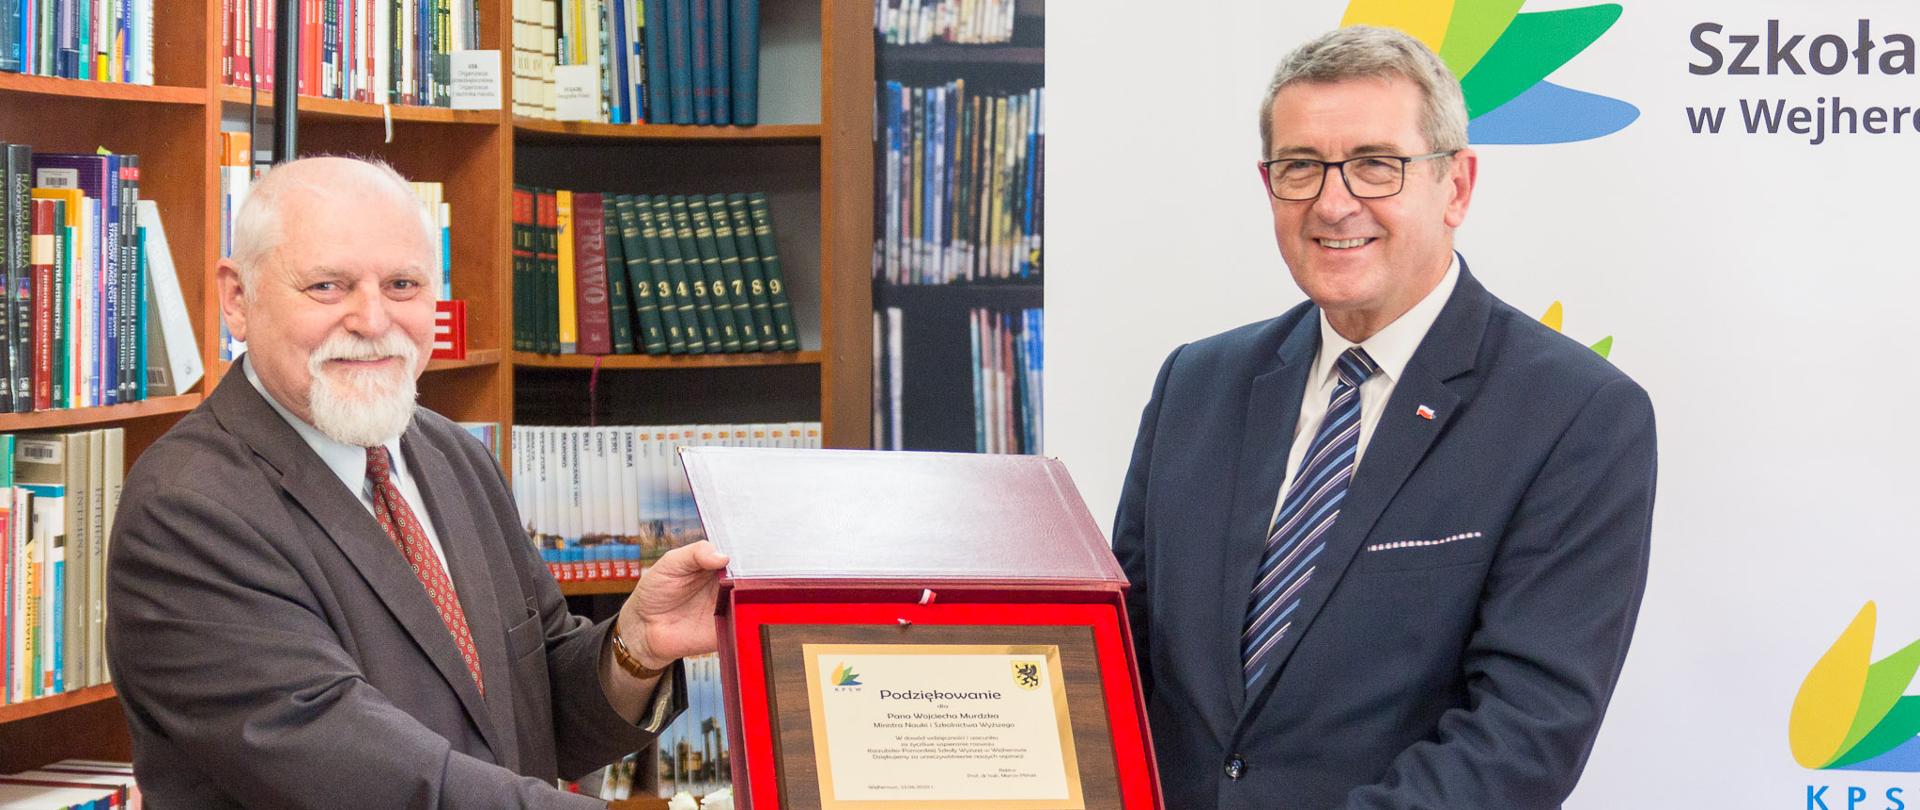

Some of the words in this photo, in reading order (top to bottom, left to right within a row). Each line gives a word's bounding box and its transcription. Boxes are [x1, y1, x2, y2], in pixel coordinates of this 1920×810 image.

[1689, 19, 1915, 75] Szkoła
[1686, 107, 1726, 134] w
[1739, 97, 1920, 145] Wejher
[22, 173, 30, 268] RADIOLOGIA
[581, 218, 605, 304] PRAWO
[638, 281, 650, 297] 2
[658, 281, 671, 298] 3
[676, 281, 688, 297] 4
[694, 280, 706, 297] 5
[713, 280, 725, 297] 6
[731, 279, 743, 295] 7
[751, 279, 763, 295] 8
[769, 279, 781, 294] 9
[582, 431, 590, 451] BALI
[596, 431, 604, 458] CHINY
[610, 430, 618, 454] PERU
[625, 431, 633, 468] JAMAJKA
[880, 689, 1002, 702] Podziękowanie
[913, 712, 958, 720] Wojciecha
[960, 712, 1000, 720] Murdzka
[979, 722, 1015, 730] Wyższego
